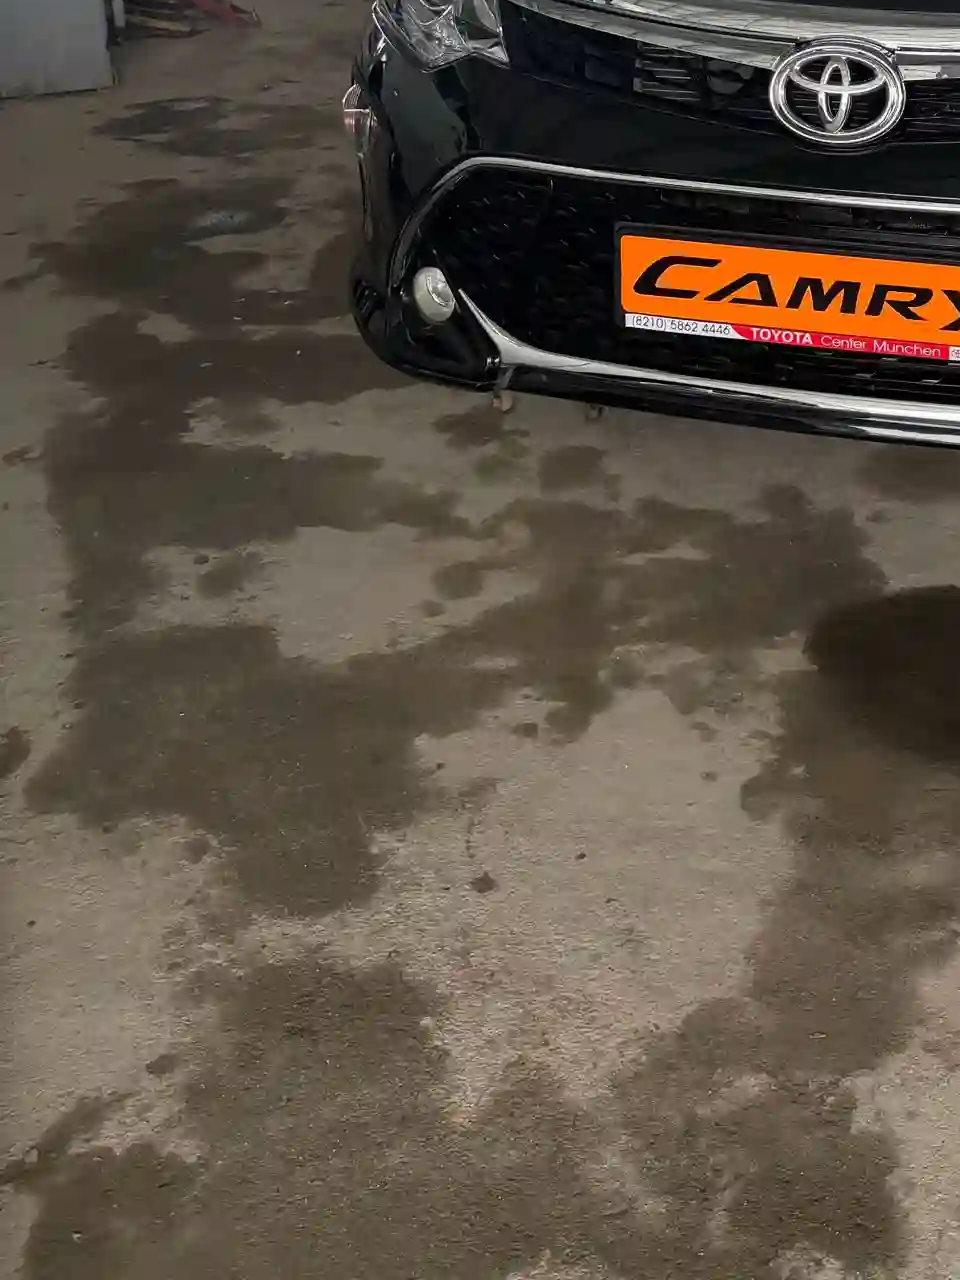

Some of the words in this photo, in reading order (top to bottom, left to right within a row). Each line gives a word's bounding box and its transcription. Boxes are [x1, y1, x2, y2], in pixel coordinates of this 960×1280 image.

[632, 315, 668, 332] (8210)
[670, 319, 698, 333] 5862
[702, 323, 731, 336] 4446
[751, 327, 814, 345] TOYOTA
[820, 335, 868, 350] Center
[873, 339, 941, 357] Munchen
